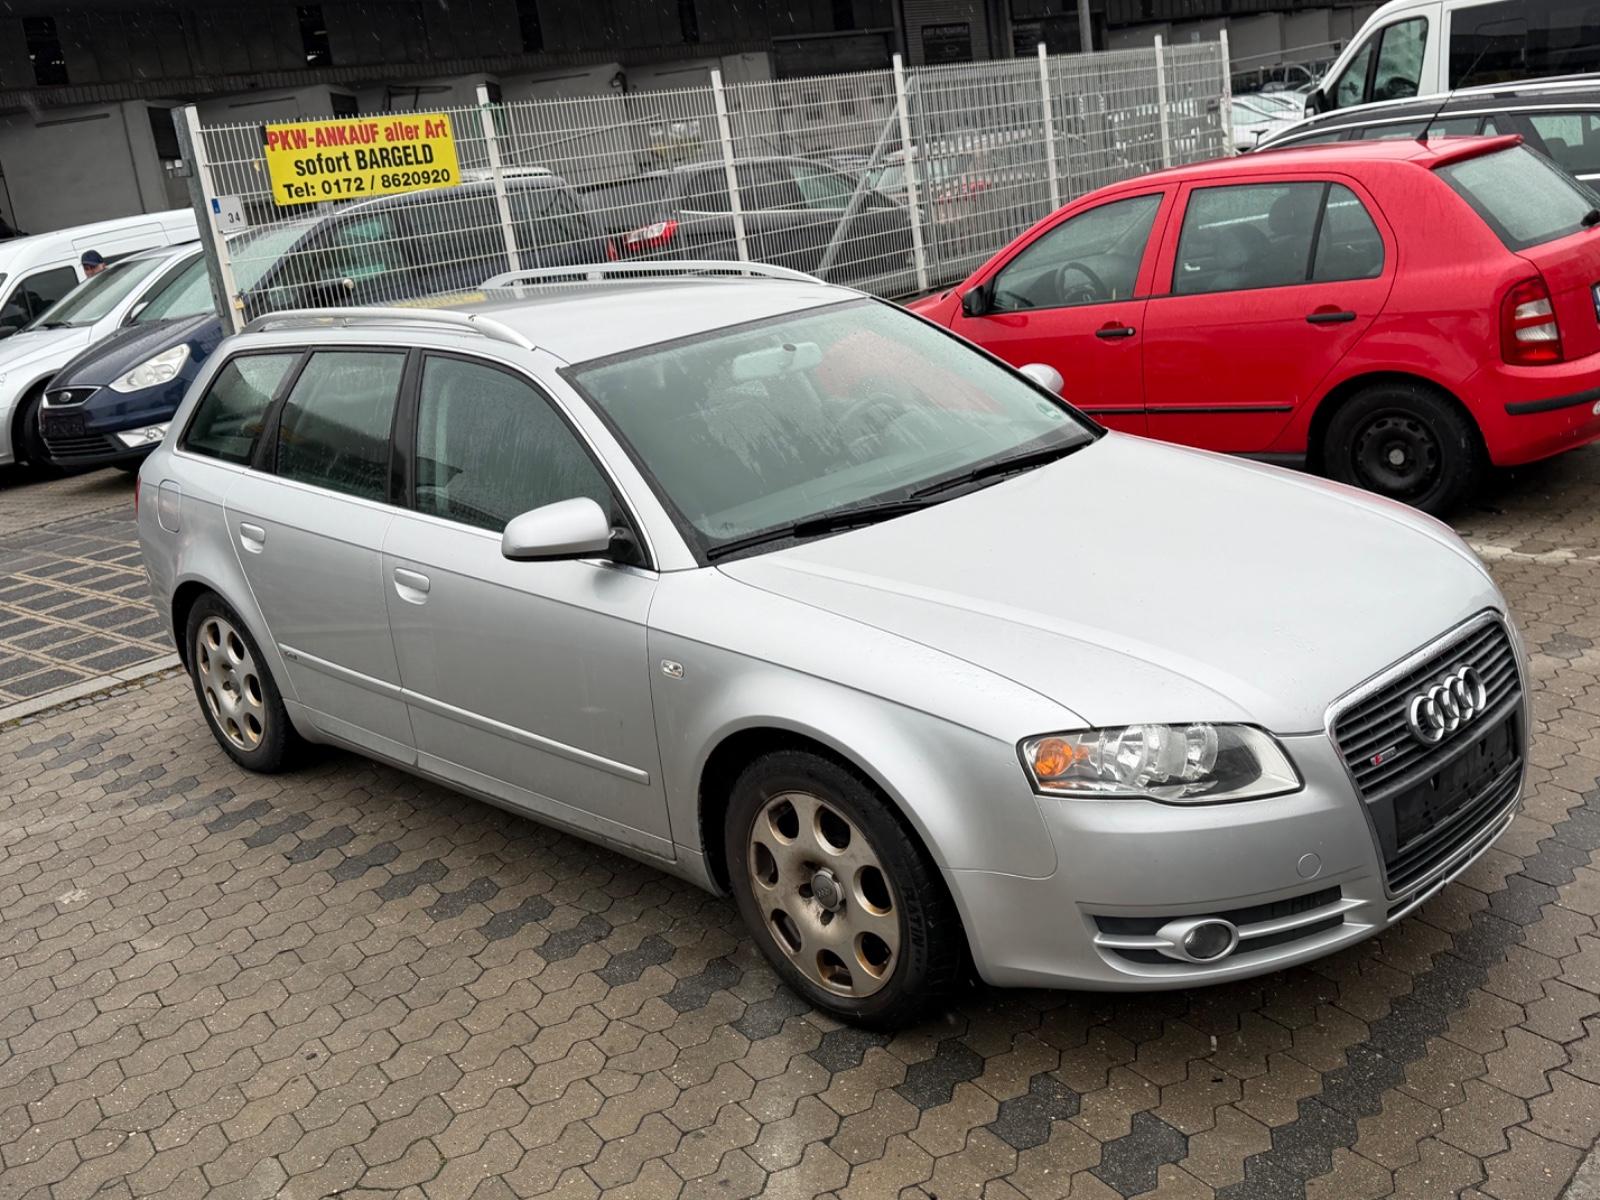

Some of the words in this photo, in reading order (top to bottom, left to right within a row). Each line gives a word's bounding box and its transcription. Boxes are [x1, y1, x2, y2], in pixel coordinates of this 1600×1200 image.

[266, 122, 380, 152] PKW-ANKAUF
[384, 121, 419, 142] aller
[424, 119, 448, 139] Art
[294, 151, 351, 177] sofort
[355, 143, 434, 170] BARGELD
[282, 182, 316, 199] Tel:
[321, 177, 365, 195] 0172
[371, 174, 375, 190] /
[381, 168, 450, 189] 8620920
[227, 211, 241, 224] 34
